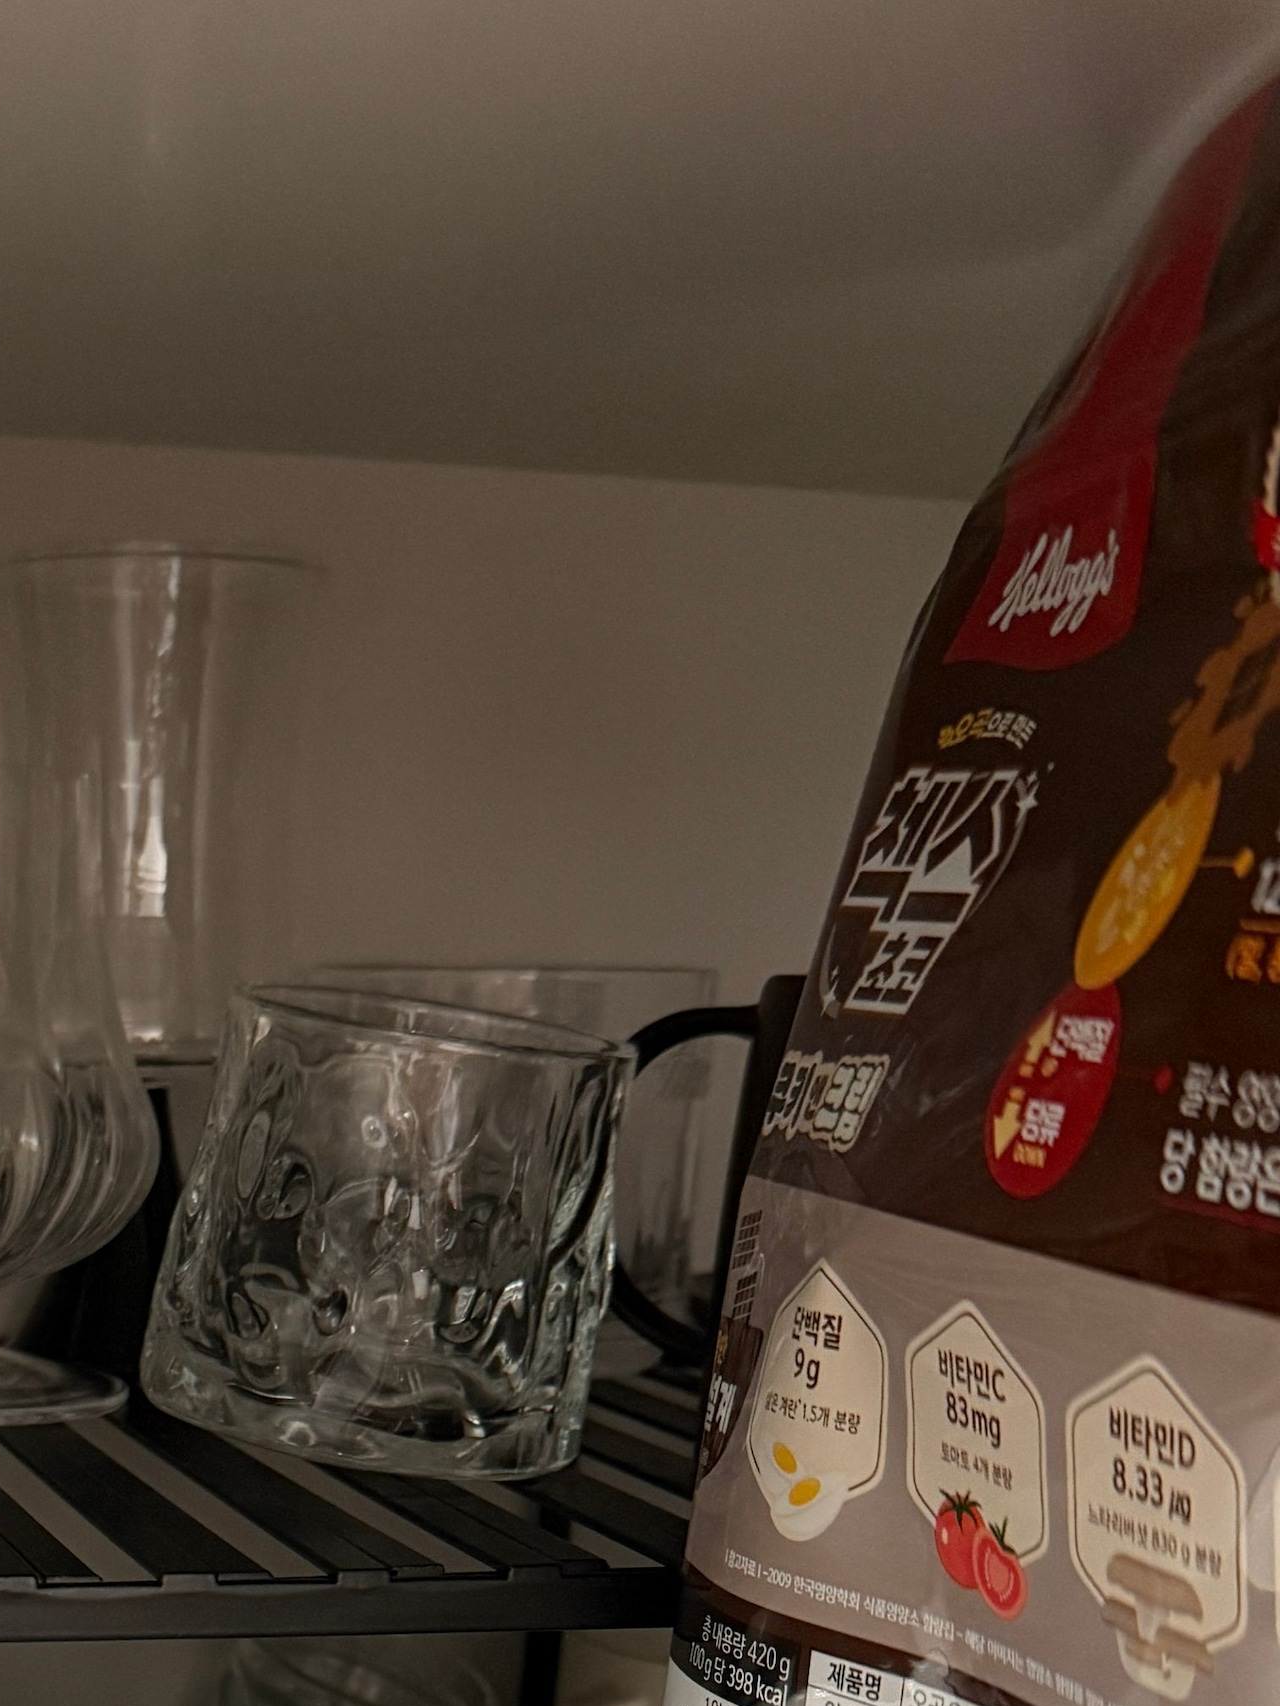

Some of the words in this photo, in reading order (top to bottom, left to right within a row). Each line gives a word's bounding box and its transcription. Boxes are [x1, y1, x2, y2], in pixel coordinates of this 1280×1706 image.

[988, 523, 1120, 638] Kellogg's
[792, 1306, 842, 1351] 단백질
[794, 1348, 820, 1389] 9g
[938, 1349, 1006, 1403] 비타민C
[834, 1410, 860, 1435] 분량
[1109, 1405, 1196, 1469] 비타민D
[1113, 1457, 1164, 1508] 8.33
[726, 1664, 753, 1696] 398
[827, 1662, 882, 1702] 제품명
